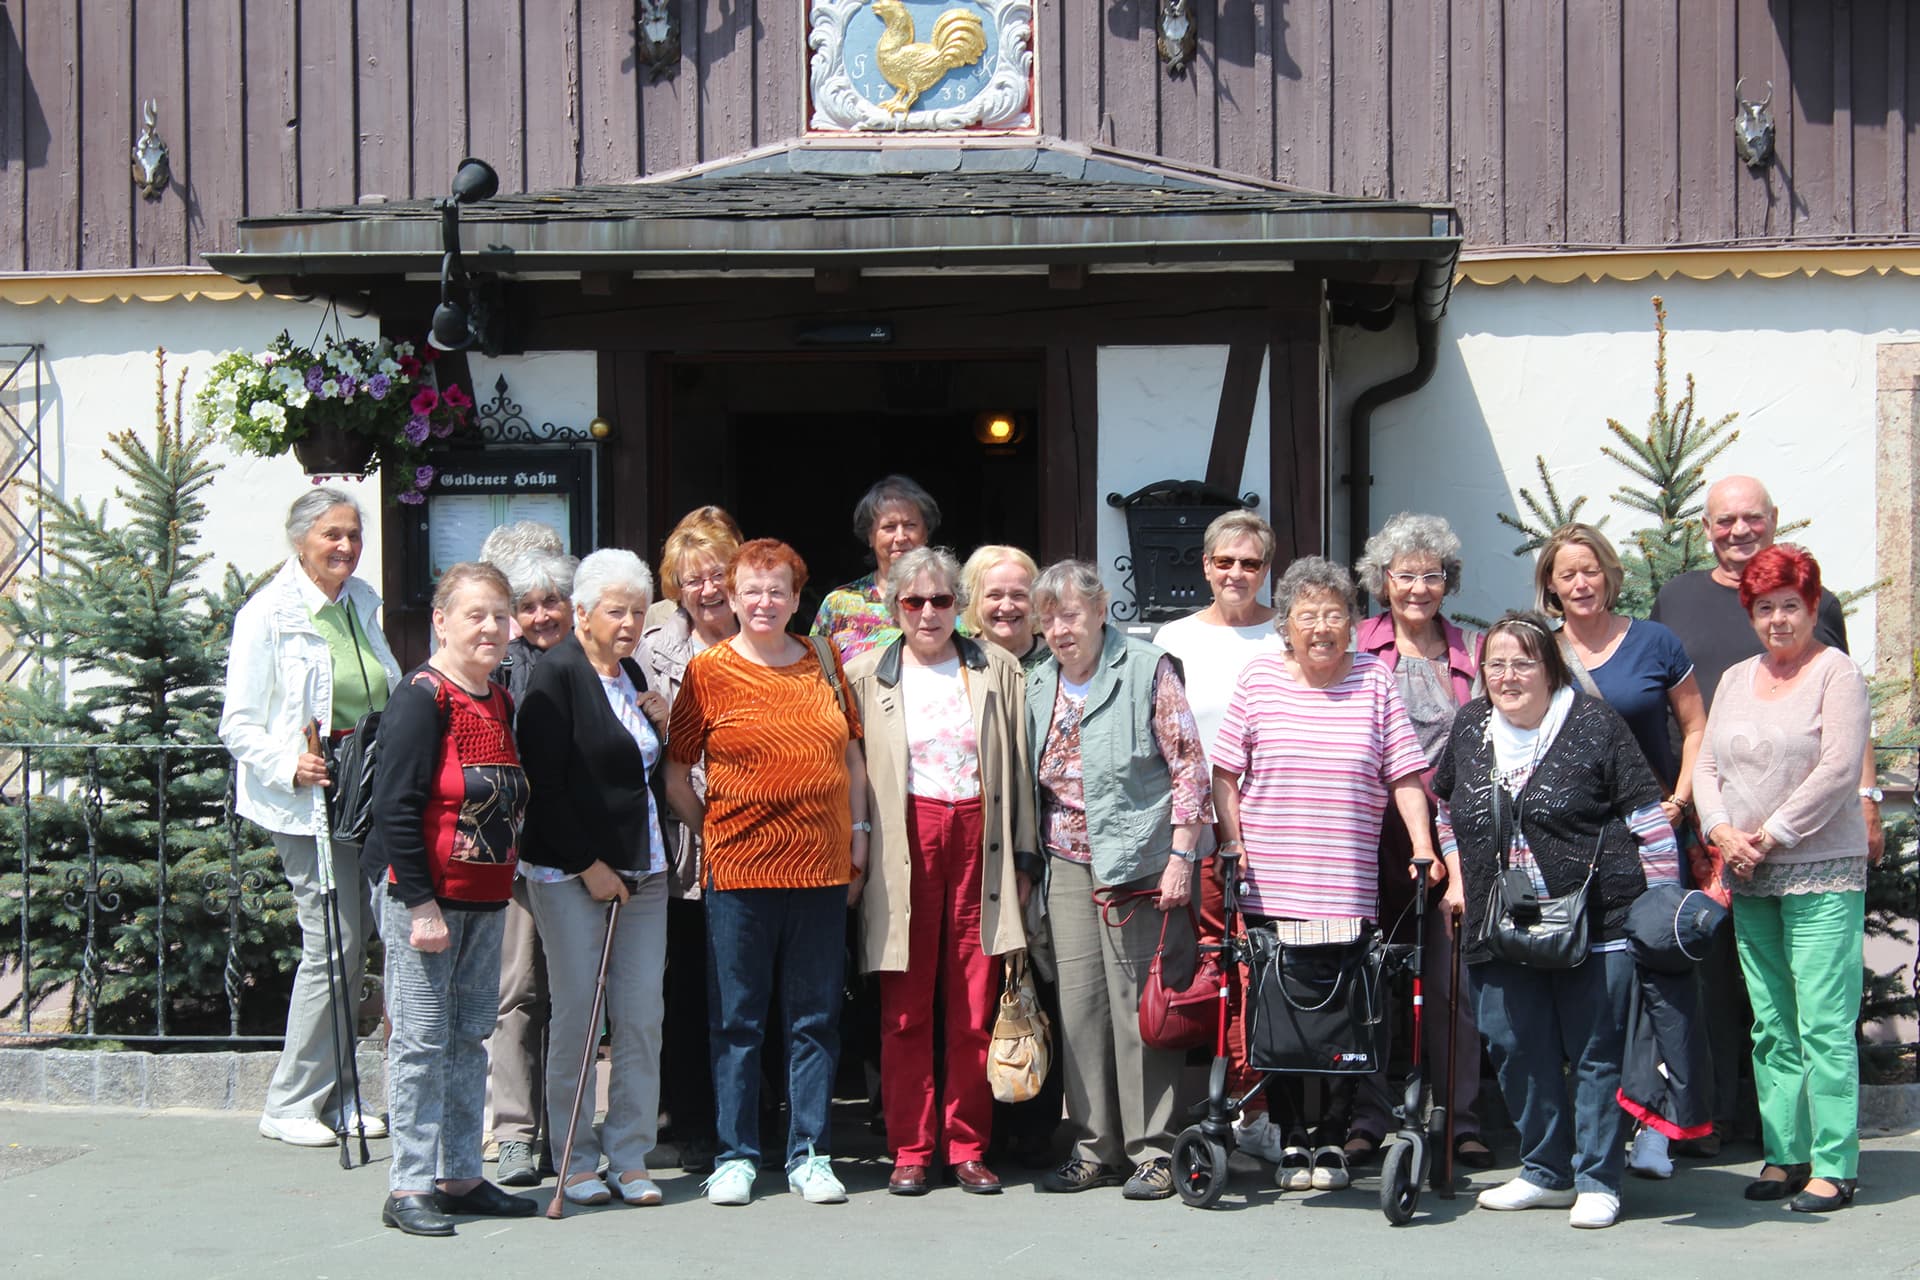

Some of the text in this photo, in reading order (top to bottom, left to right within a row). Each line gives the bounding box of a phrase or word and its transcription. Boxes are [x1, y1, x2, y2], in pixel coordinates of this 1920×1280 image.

[864, 84, 967, 99] 17 38
[440, 472, 557, 487] Goldener Hahn
